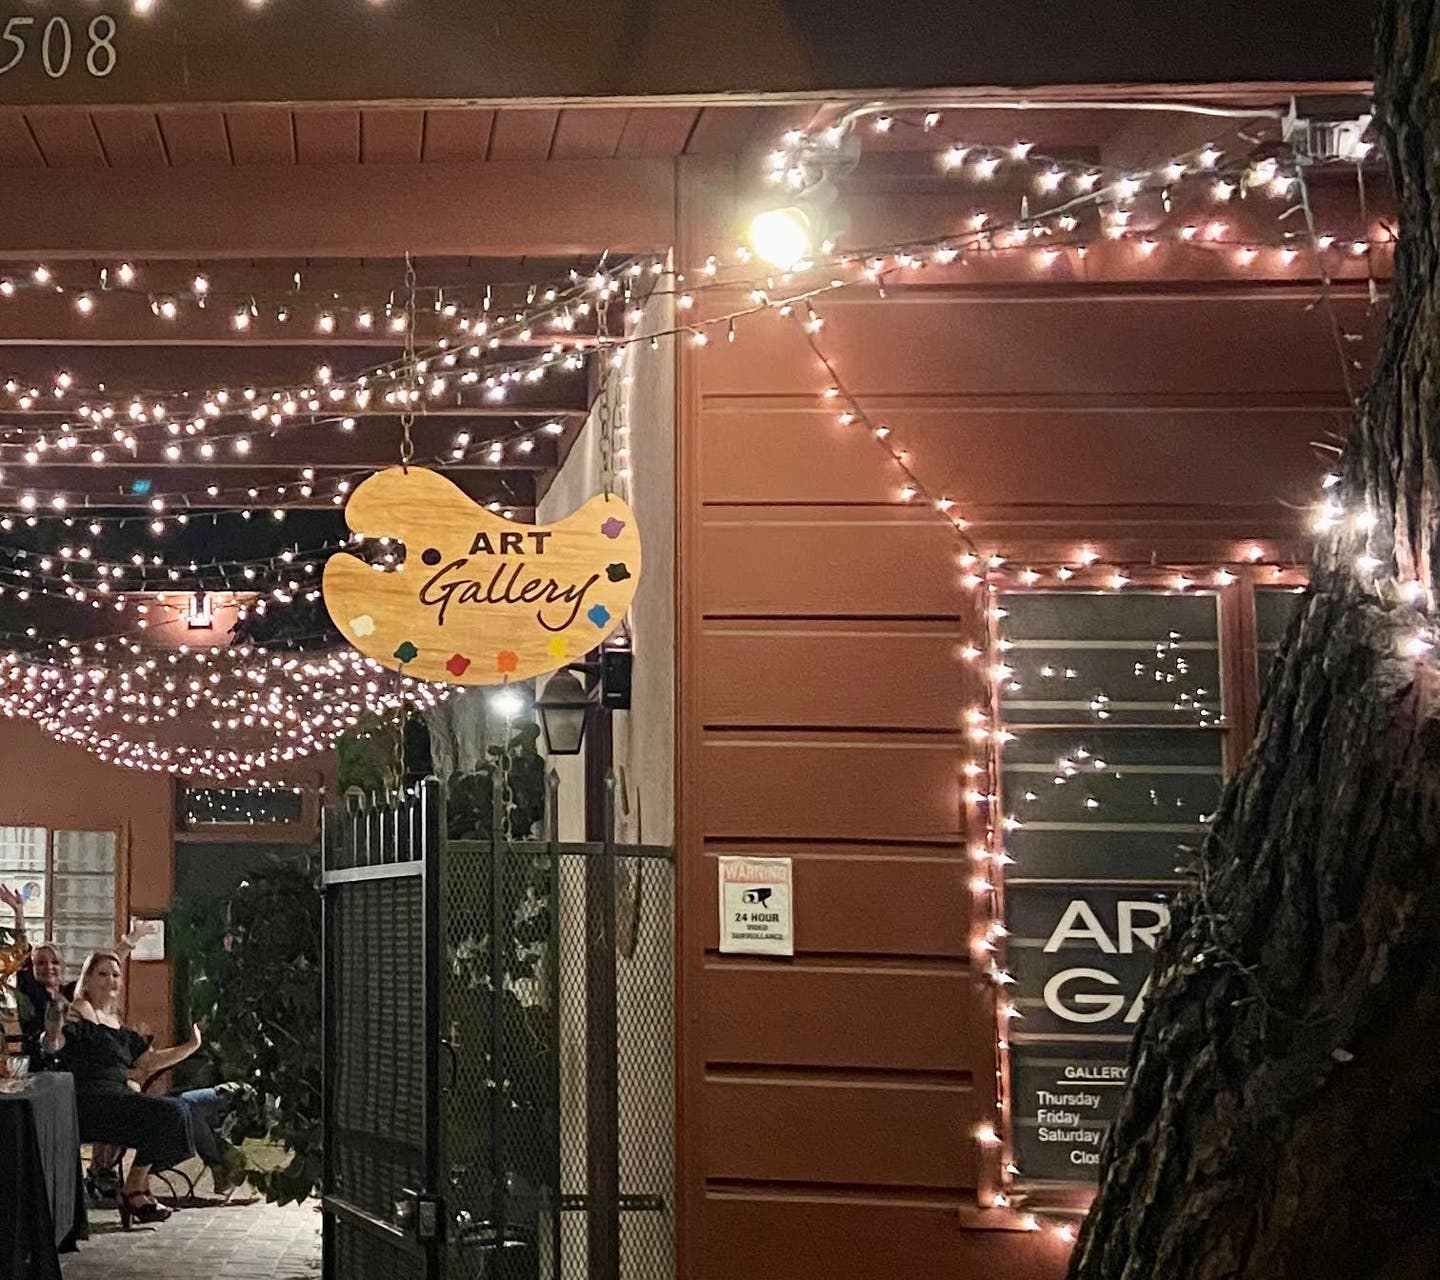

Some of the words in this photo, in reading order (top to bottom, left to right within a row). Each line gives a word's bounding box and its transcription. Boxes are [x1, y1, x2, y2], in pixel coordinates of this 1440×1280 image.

[468, 531, 553, 556] ART
[418, 557, 601, 632] Gallery
[734, 912, 749, 923] 24
[750, 912, 780, 923] HOUR
[1063, 1065, 1129, 1080] GALLERY
[1036, 1090, 1101, 1110] Thursday
[1036, 1108, 1081, 1127] Friday
[1038, 1126, 1101, 1146] Saturday
